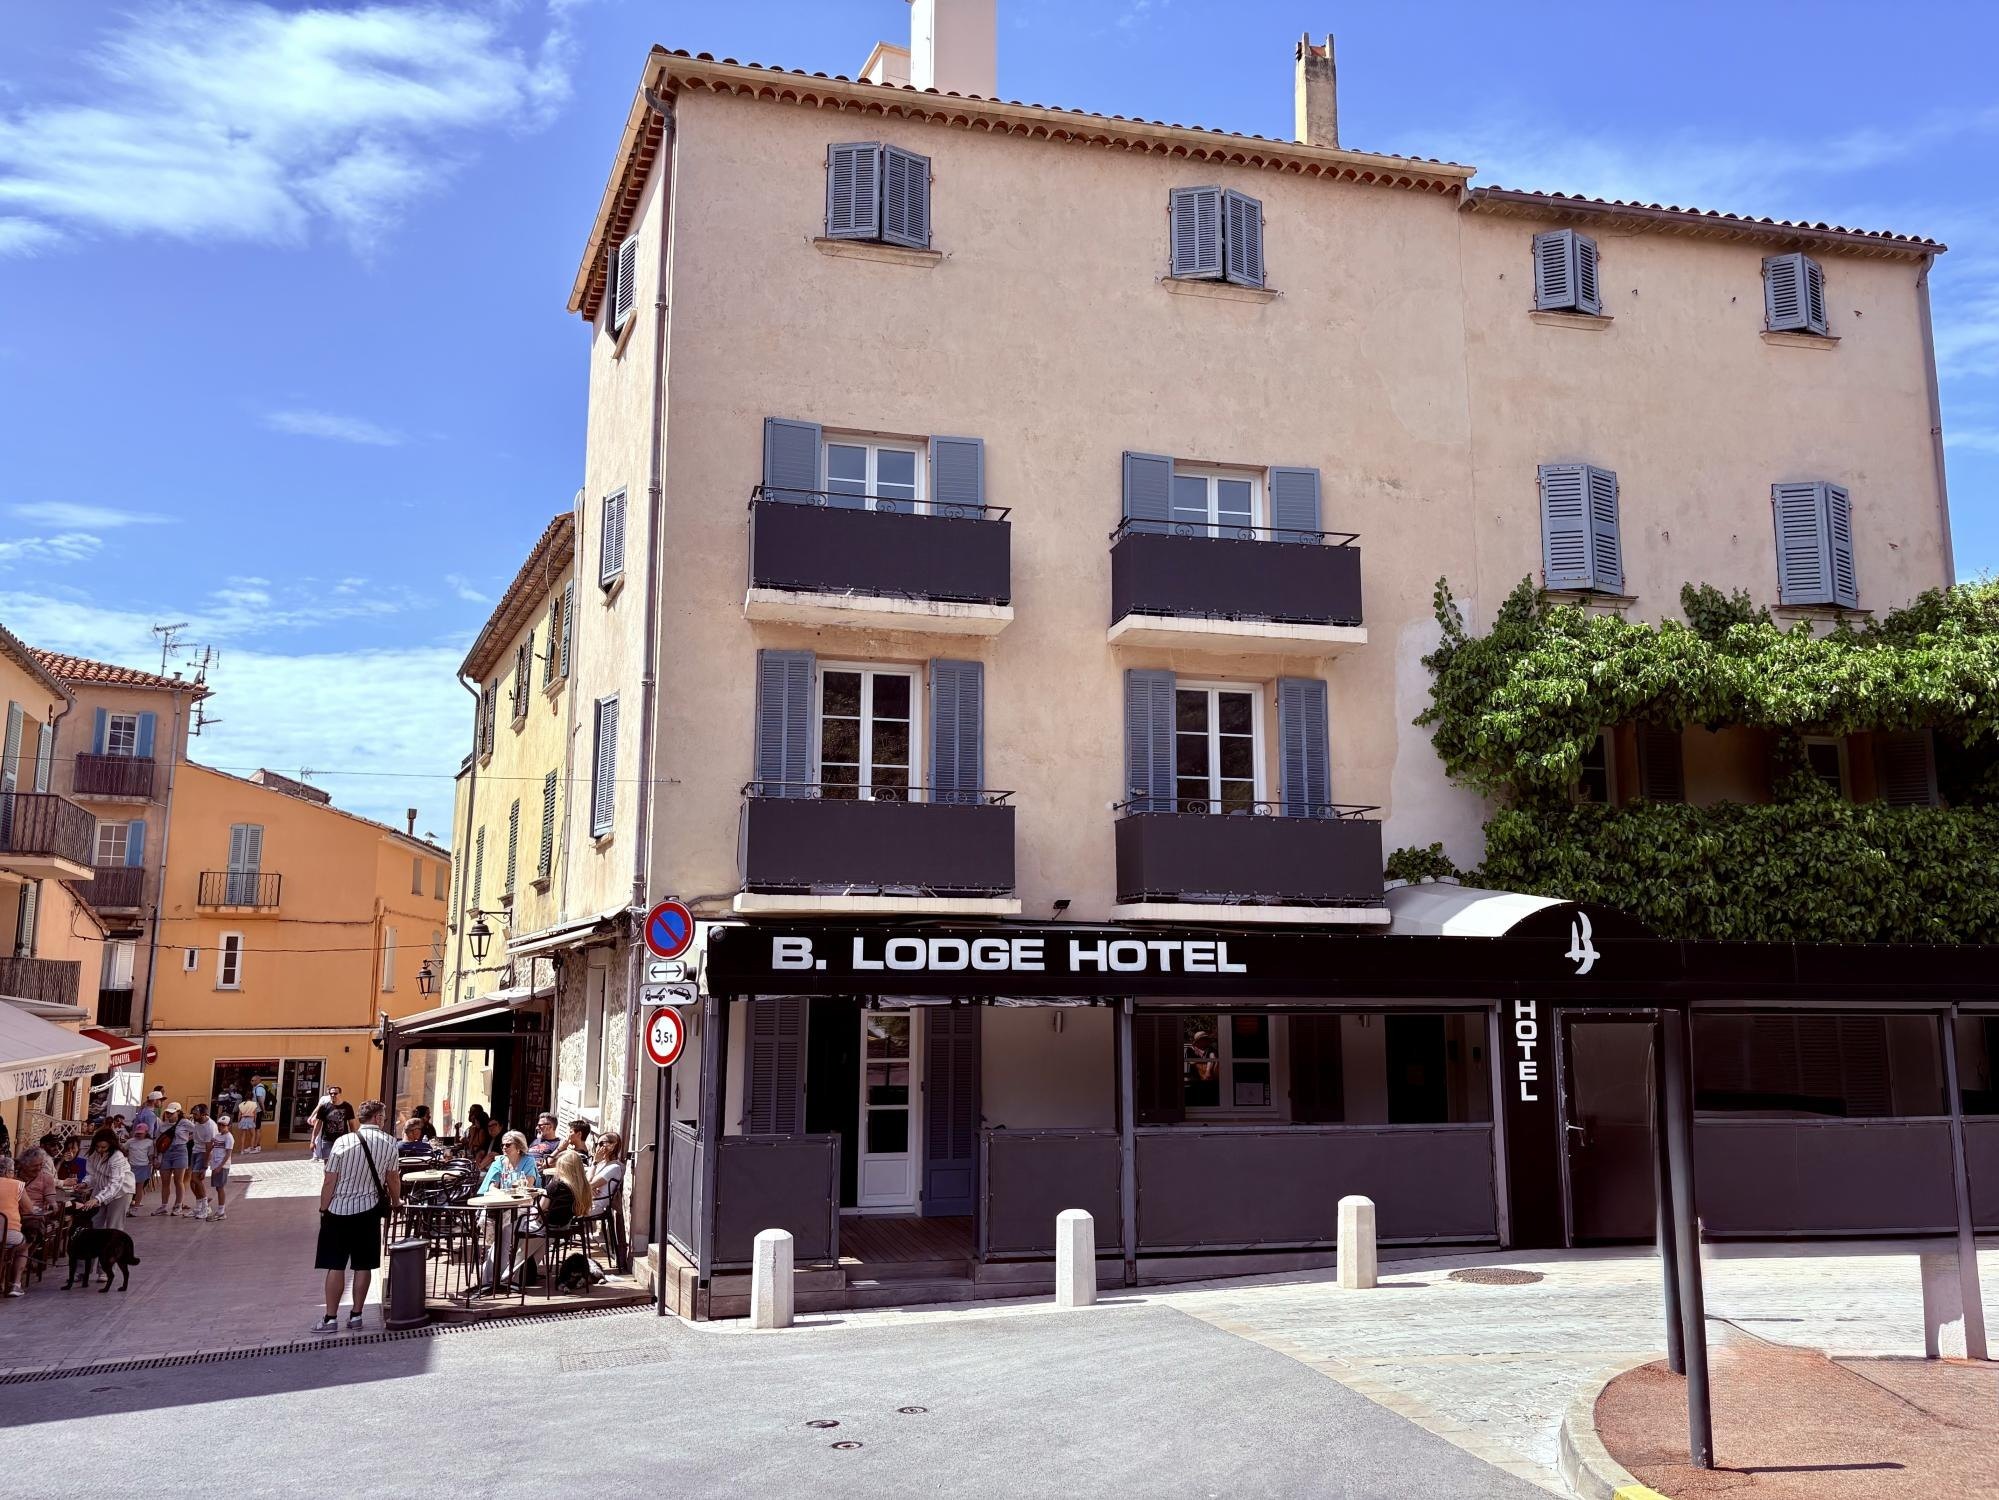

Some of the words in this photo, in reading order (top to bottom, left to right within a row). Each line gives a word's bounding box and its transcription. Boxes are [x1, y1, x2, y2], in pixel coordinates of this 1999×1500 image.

[772, 936, 827, 970] B.
[852, 936, 1046, 971] LODGE
[1069, 939, 1247, 973] HOTEL
[655, 1028, 673, 1046] 3,5t
[1514, 999, 1538, 1102] HOTEL
